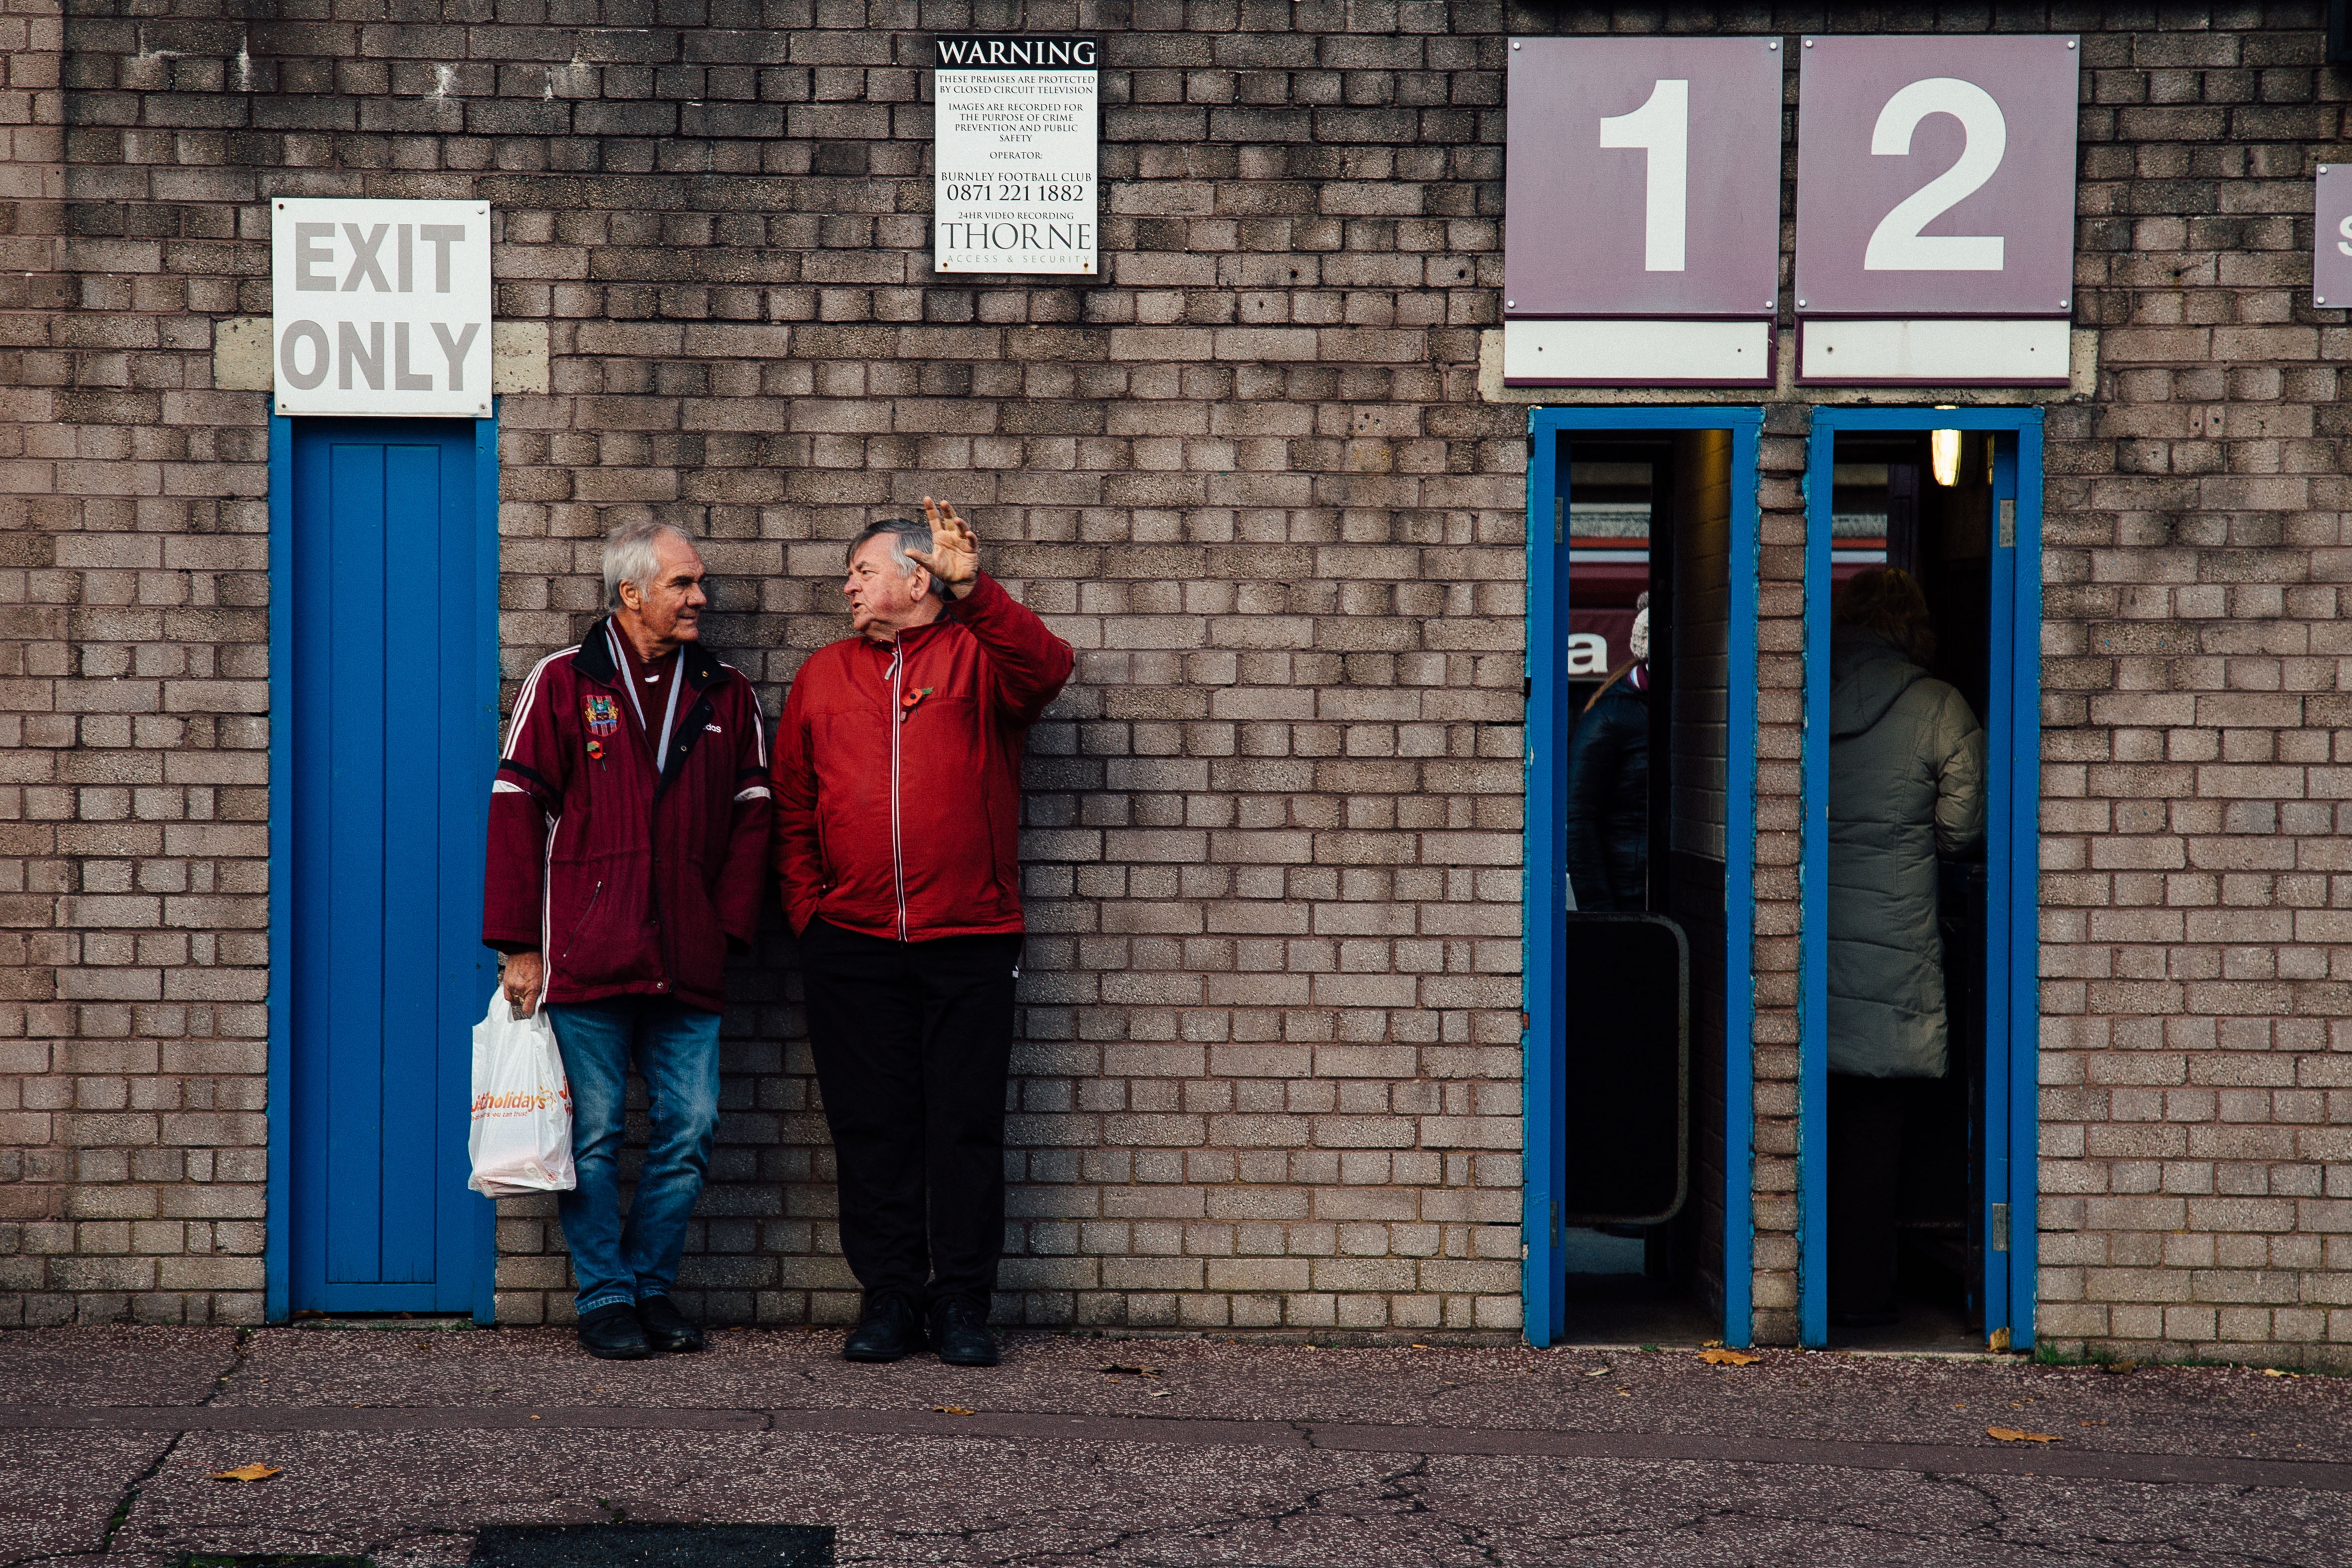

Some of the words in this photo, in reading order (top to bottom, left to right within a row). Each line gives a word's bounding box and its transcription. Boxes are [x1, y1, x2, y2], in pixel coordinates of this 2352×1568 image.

[937, 40, 1096, 65] WARNING
[938, 75, 967, 83] THESE
[971, 75, 1015, 83] PREMISES
[1018, 75, 1035, 83] ARE
[1039, 75, 1095, 84] PROTECTED
[954, 85, 991, 94] CLOSED
[994, 85, 1035, 94] CIRCUIT
[948, 103, 984, 111] IMAGES
[987, 103, 1004, 111] ARE
[1008, 103, 1061, 111] RECORDED
[1064, 103, 1083, 111] FOR
[941, 172, 994, 181] BURNLEY
[998, 172, 1058, 182] FOOTBALL
[1061, 172, 1091, 182] CLUB
[1600, 79, 1689, 270] 1
[1864, 76, 2007, 270] 2
[947, 184, 991, 201] 0871
[999, 184, 1030, 201] 221
[1039, 185, 1083, 201] 1882
[941, 223, 1091, 250] THORNE
[295, 223, 465, 293] EXIT
[947, 255, 998, 263] ACCESS
[280, 319, 481, 391] ONLY
